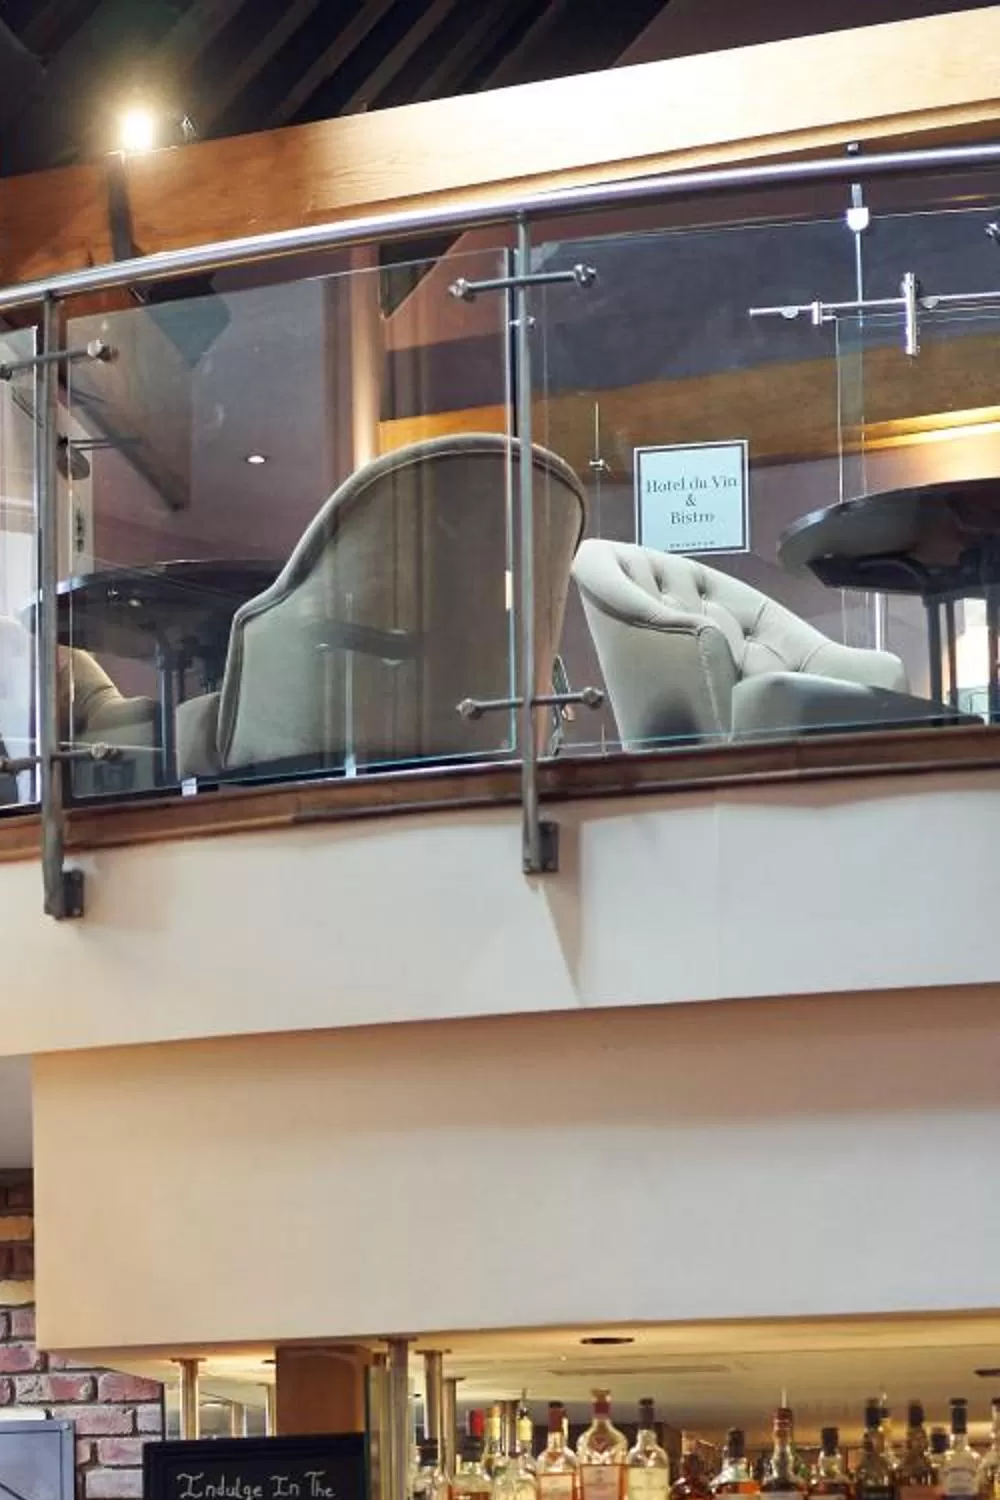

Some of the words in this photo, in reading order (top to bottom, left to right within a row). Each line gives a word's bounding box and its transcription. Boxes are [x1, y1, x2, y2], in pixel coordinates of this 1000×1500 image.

[646, 476, 685, 493] Hotel
[689, 475, 707, 490] du
[712, 474, 738, 488] Vin
[685, 493, 697, 507] &
[670, 510, 717, 525] Bistro
[270, 1475, 300, 1498] In
[304, 1470, 336, 1498] The
